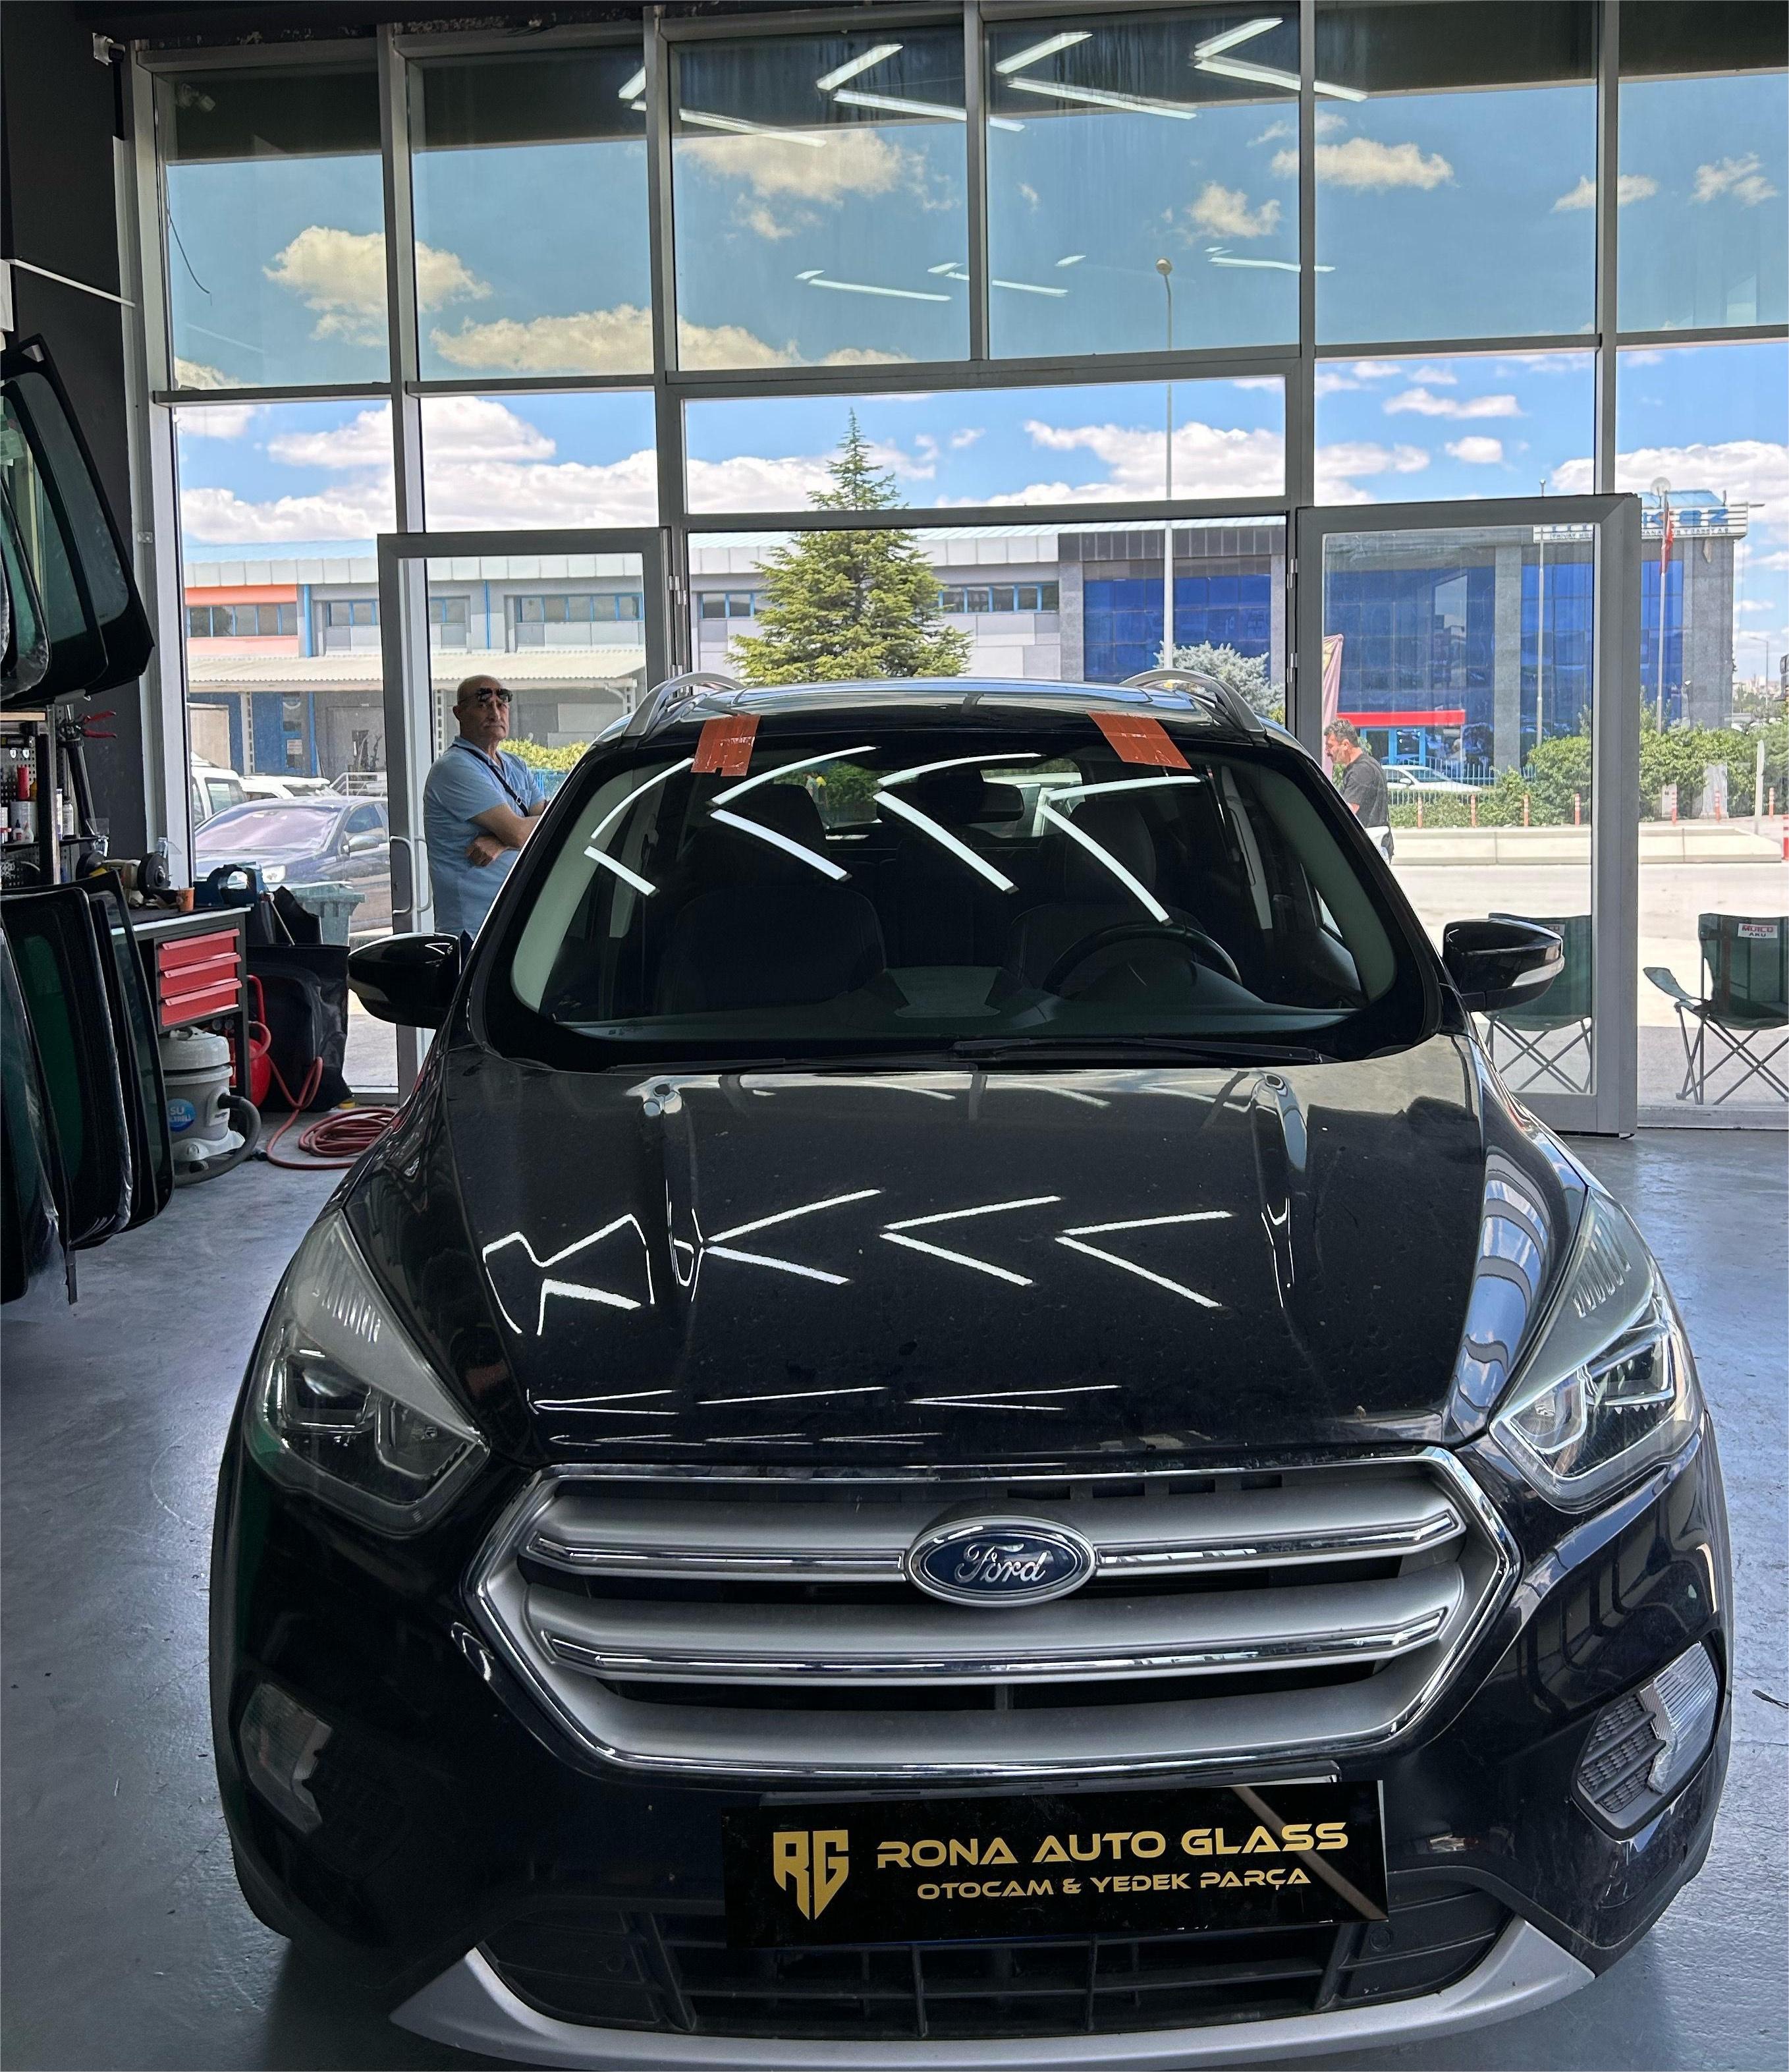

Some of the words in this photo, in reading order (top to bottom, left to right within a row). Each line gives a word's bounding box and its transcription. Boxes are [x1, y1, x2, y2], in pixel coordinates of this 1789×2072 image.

[955, 1542, 1048, 1582] Ford
[877, 1837, 1016, 1868] RONA
[1033, 1830, 1166, 1863] AUTO
[1180, 1822, 1348, 1856] GLASS
[773, 1830, 849, 1920] RG
[917, 1880, 1053, 1899] OTOCAM
[1063, 1878, 1079, 1893] &
[1093, 1874, 1189, 1892] YEDEK
[1200, 1868, 1311, 1891] PARÇA
